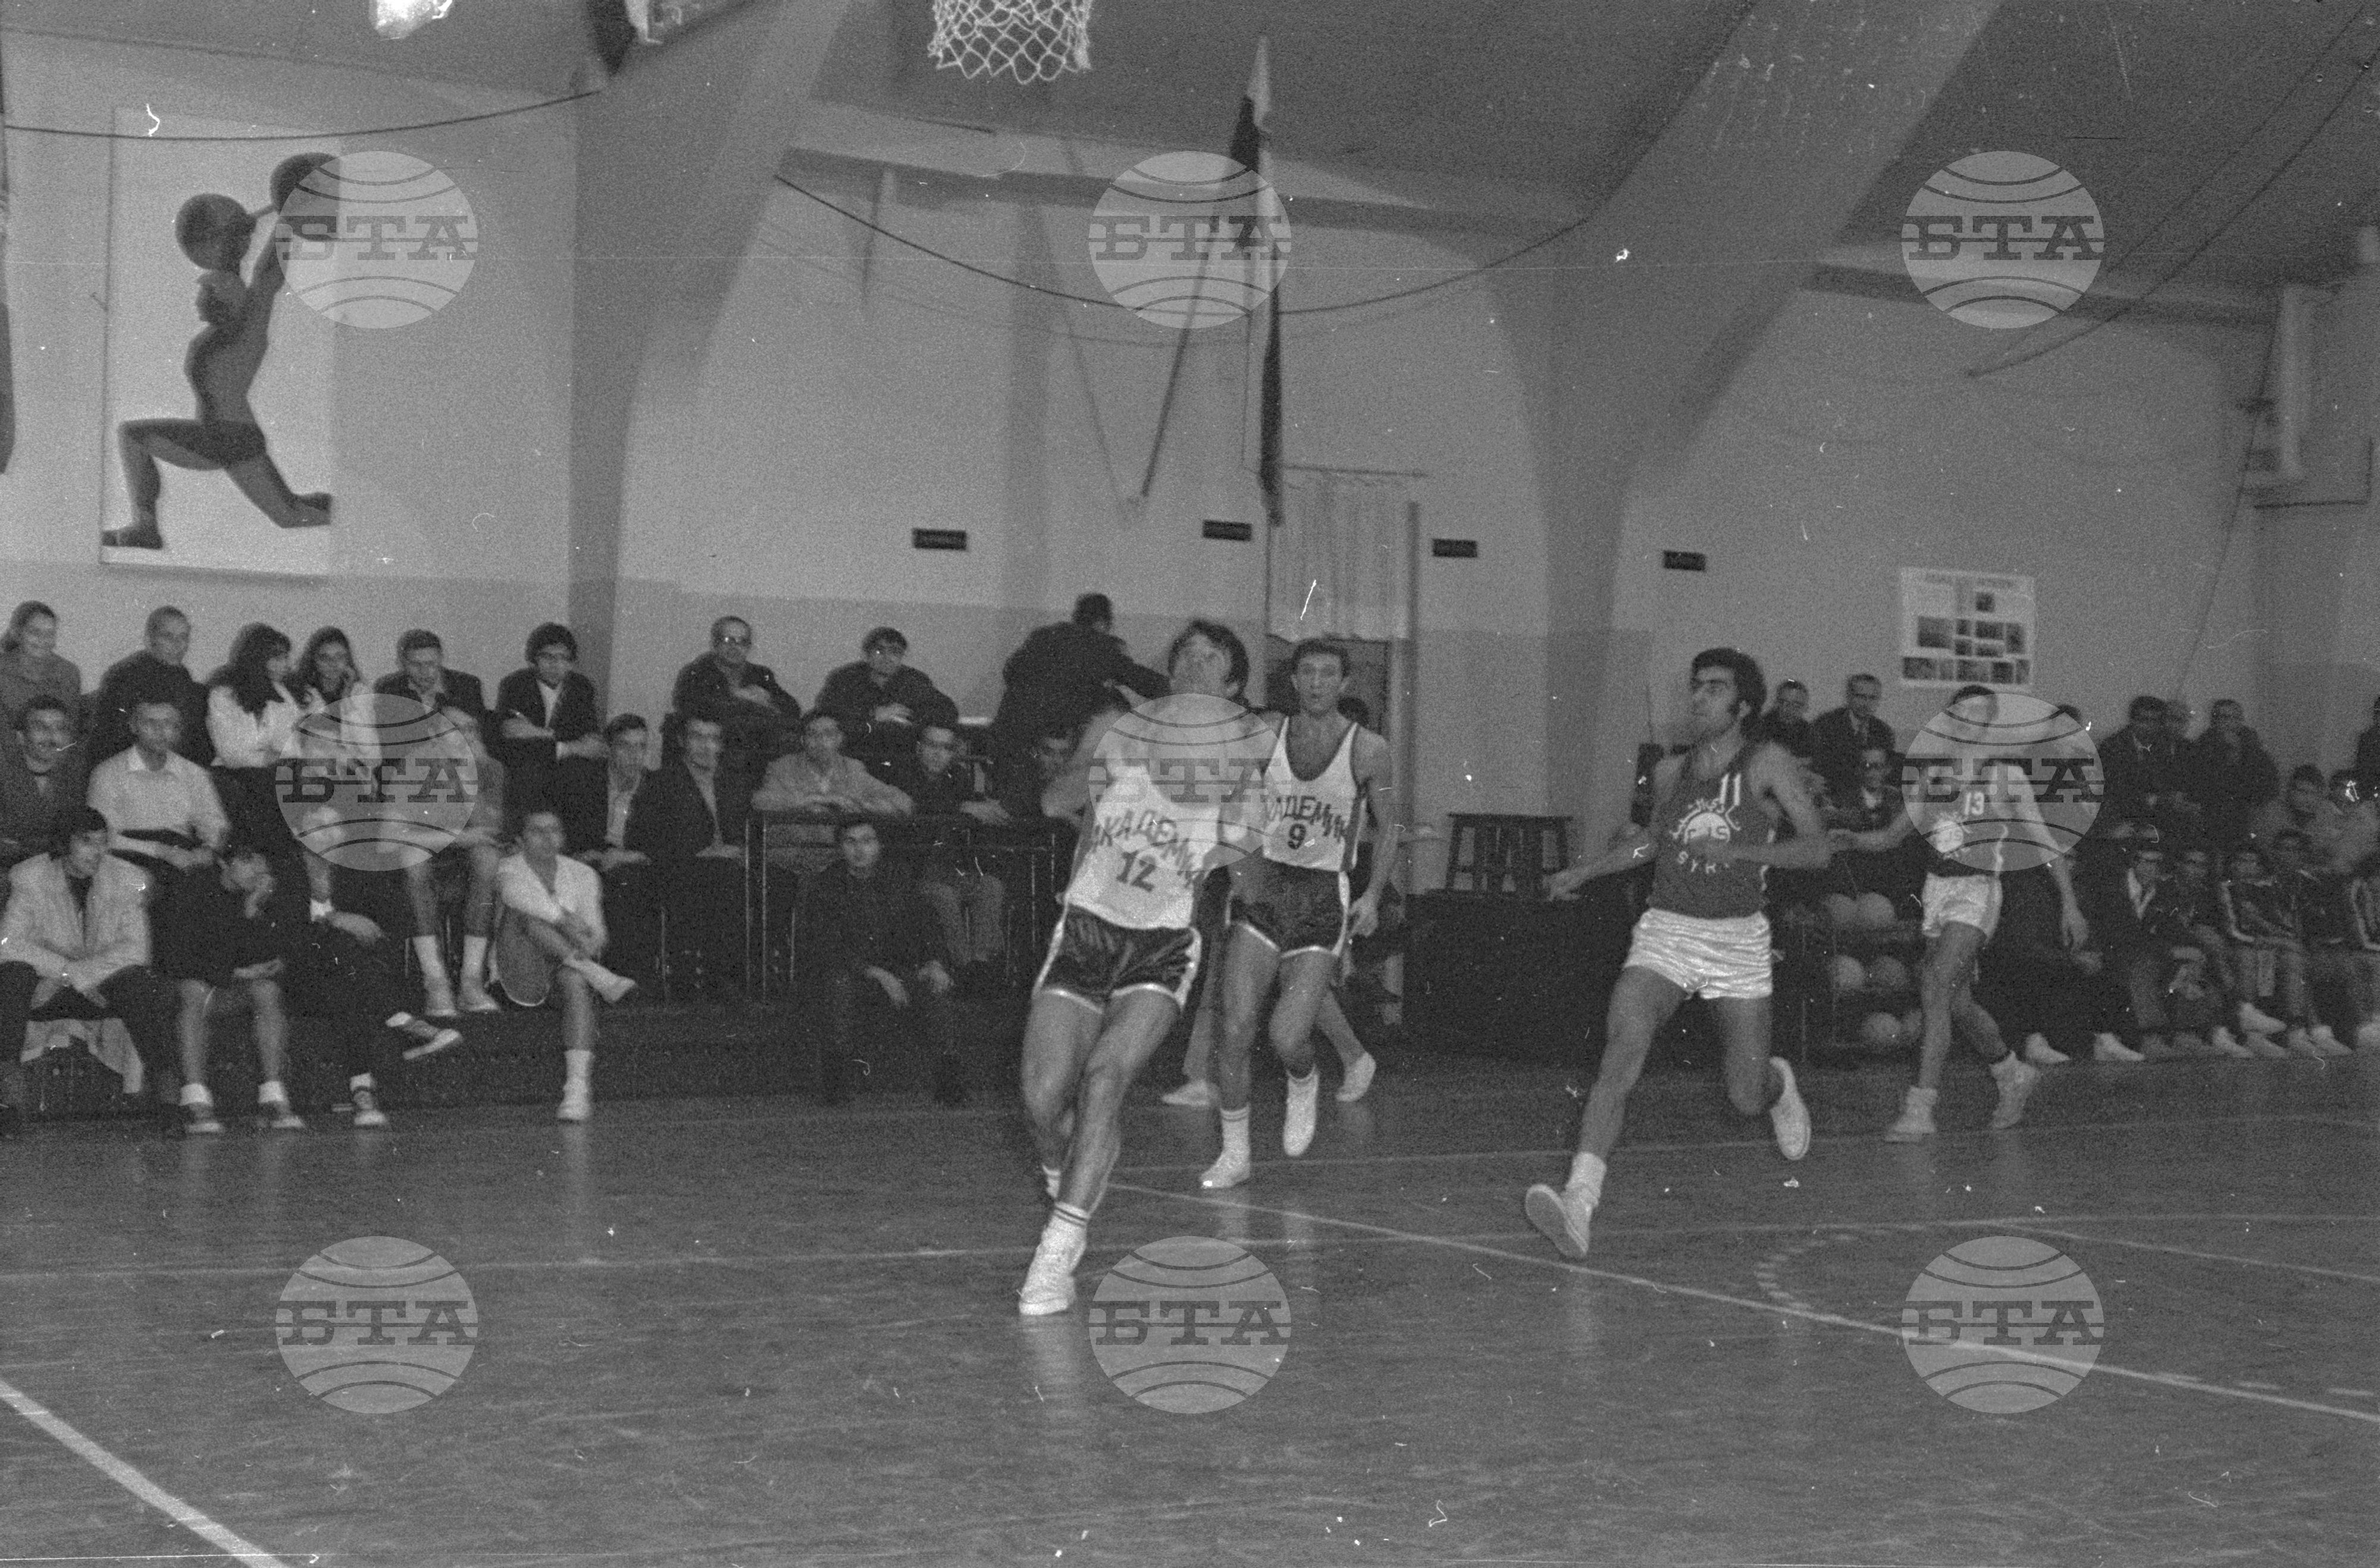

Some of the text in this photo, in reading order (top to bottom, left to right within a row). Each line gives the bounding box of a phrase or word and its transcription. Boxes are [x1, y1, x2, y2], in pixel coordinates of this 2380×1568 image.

[1719, 773, 1742, 807] 11
[1965, 791, 1985, 816] 13
[1288, 823, 1307, 849] 9
[1115, 849, 1156, 892] 12
